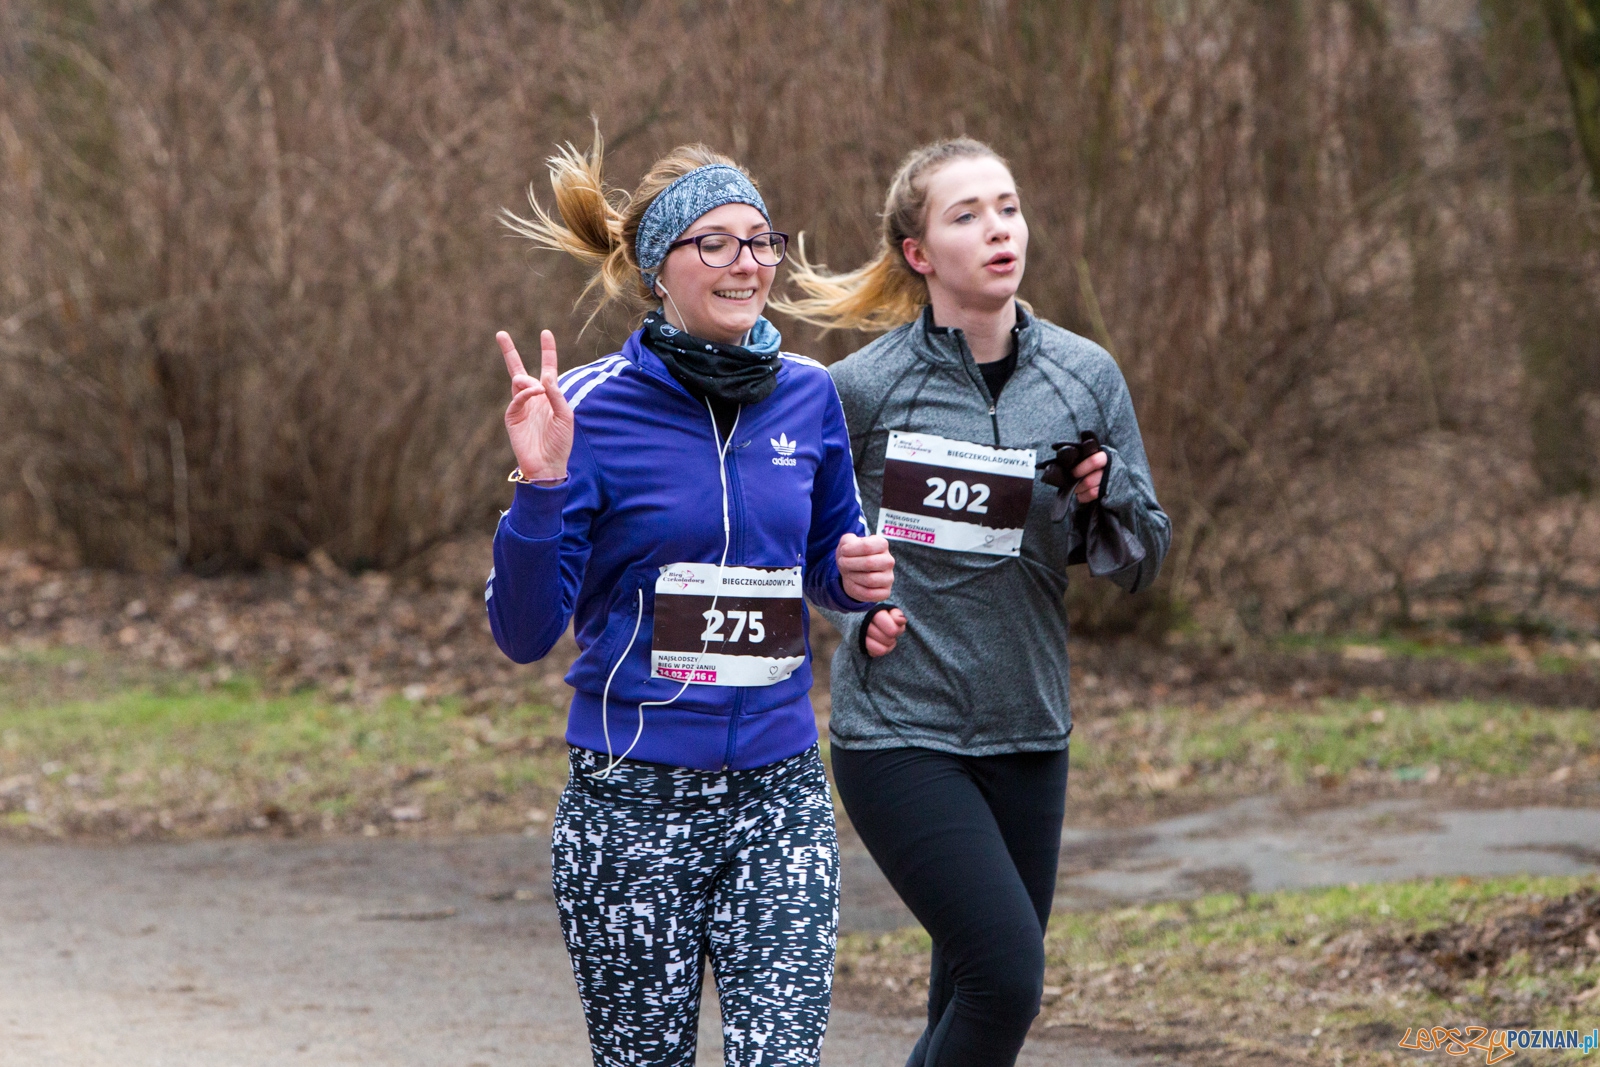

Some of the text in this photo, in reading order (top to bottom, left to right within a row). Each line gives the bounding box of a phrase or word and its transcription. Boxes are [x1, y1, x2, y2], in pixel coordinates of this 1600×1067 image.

[771, 456, 797, 467] adidas
[947, 449, 1029, 468] BIEGCZEKOLADOWY.PL
[922, 476, 991, 514] 202
[884, 526, 935, 543] 14.02.2016 r.
[722, 577, 796, 587] BIEGCZEKOLADOWY.PL
[700, 609, 766, 643] 275
[658, 655, 699, 663] NAJSŁODSZY
[707, 674, 716, 682] r.
